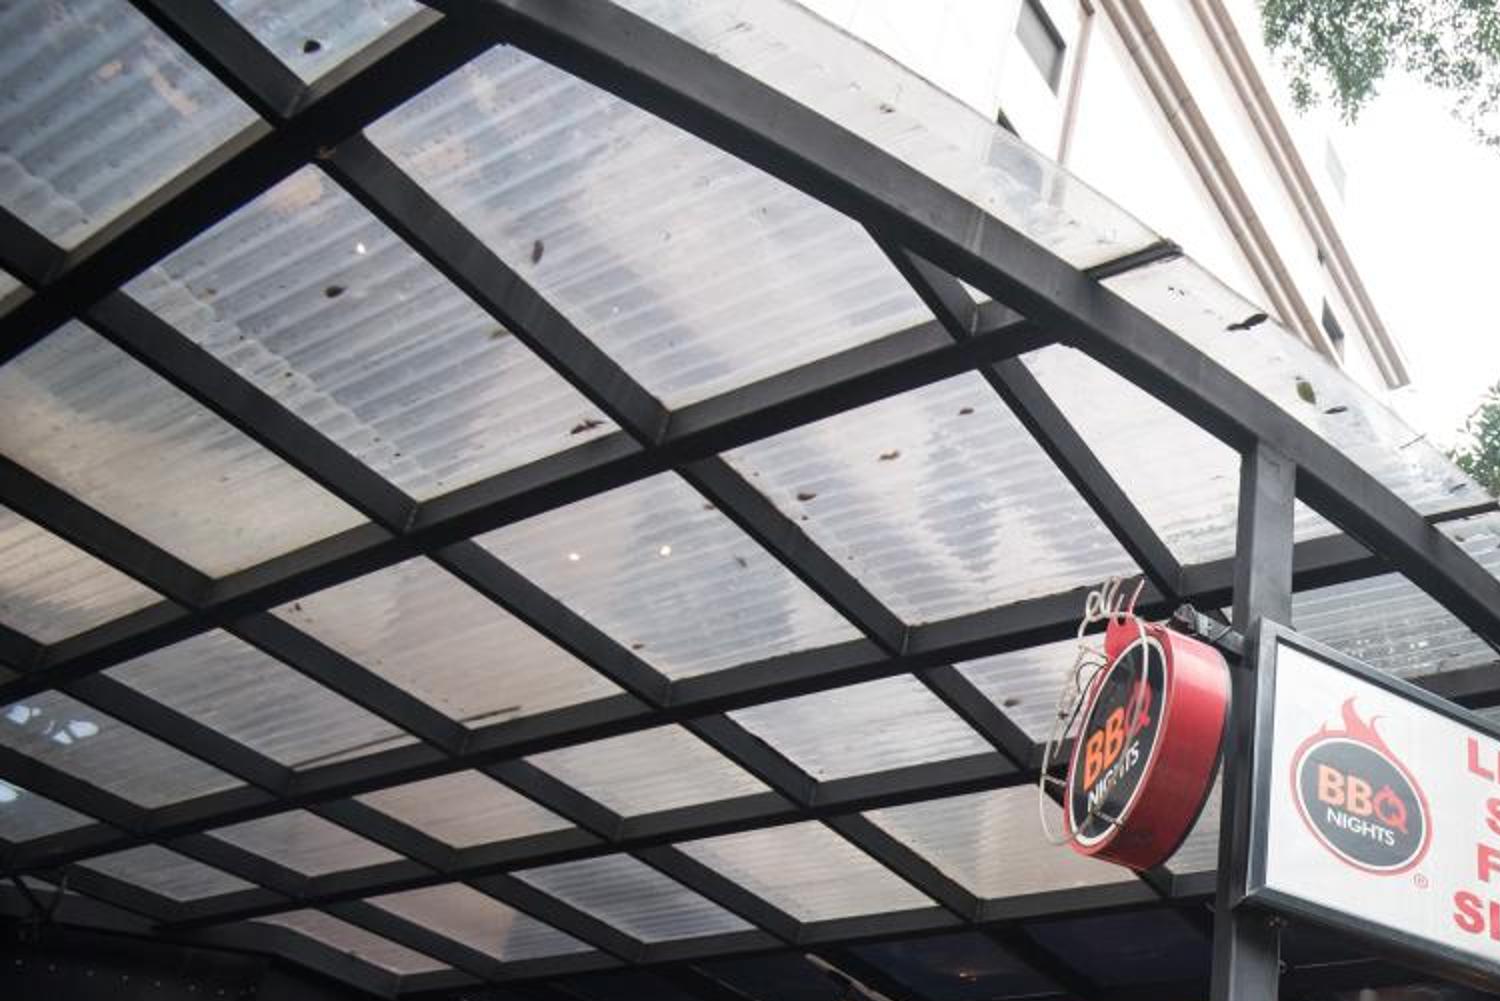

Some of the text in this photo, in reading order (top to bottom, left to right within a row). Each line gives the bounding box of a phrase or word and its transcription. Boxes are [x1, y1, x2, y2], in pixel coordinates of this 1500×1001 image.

[1084, 678, 1152, 791] BBQ
[1317, 763, 1408, 833] BBQ
[1326, 807, 1396, 846] NIGHTS
